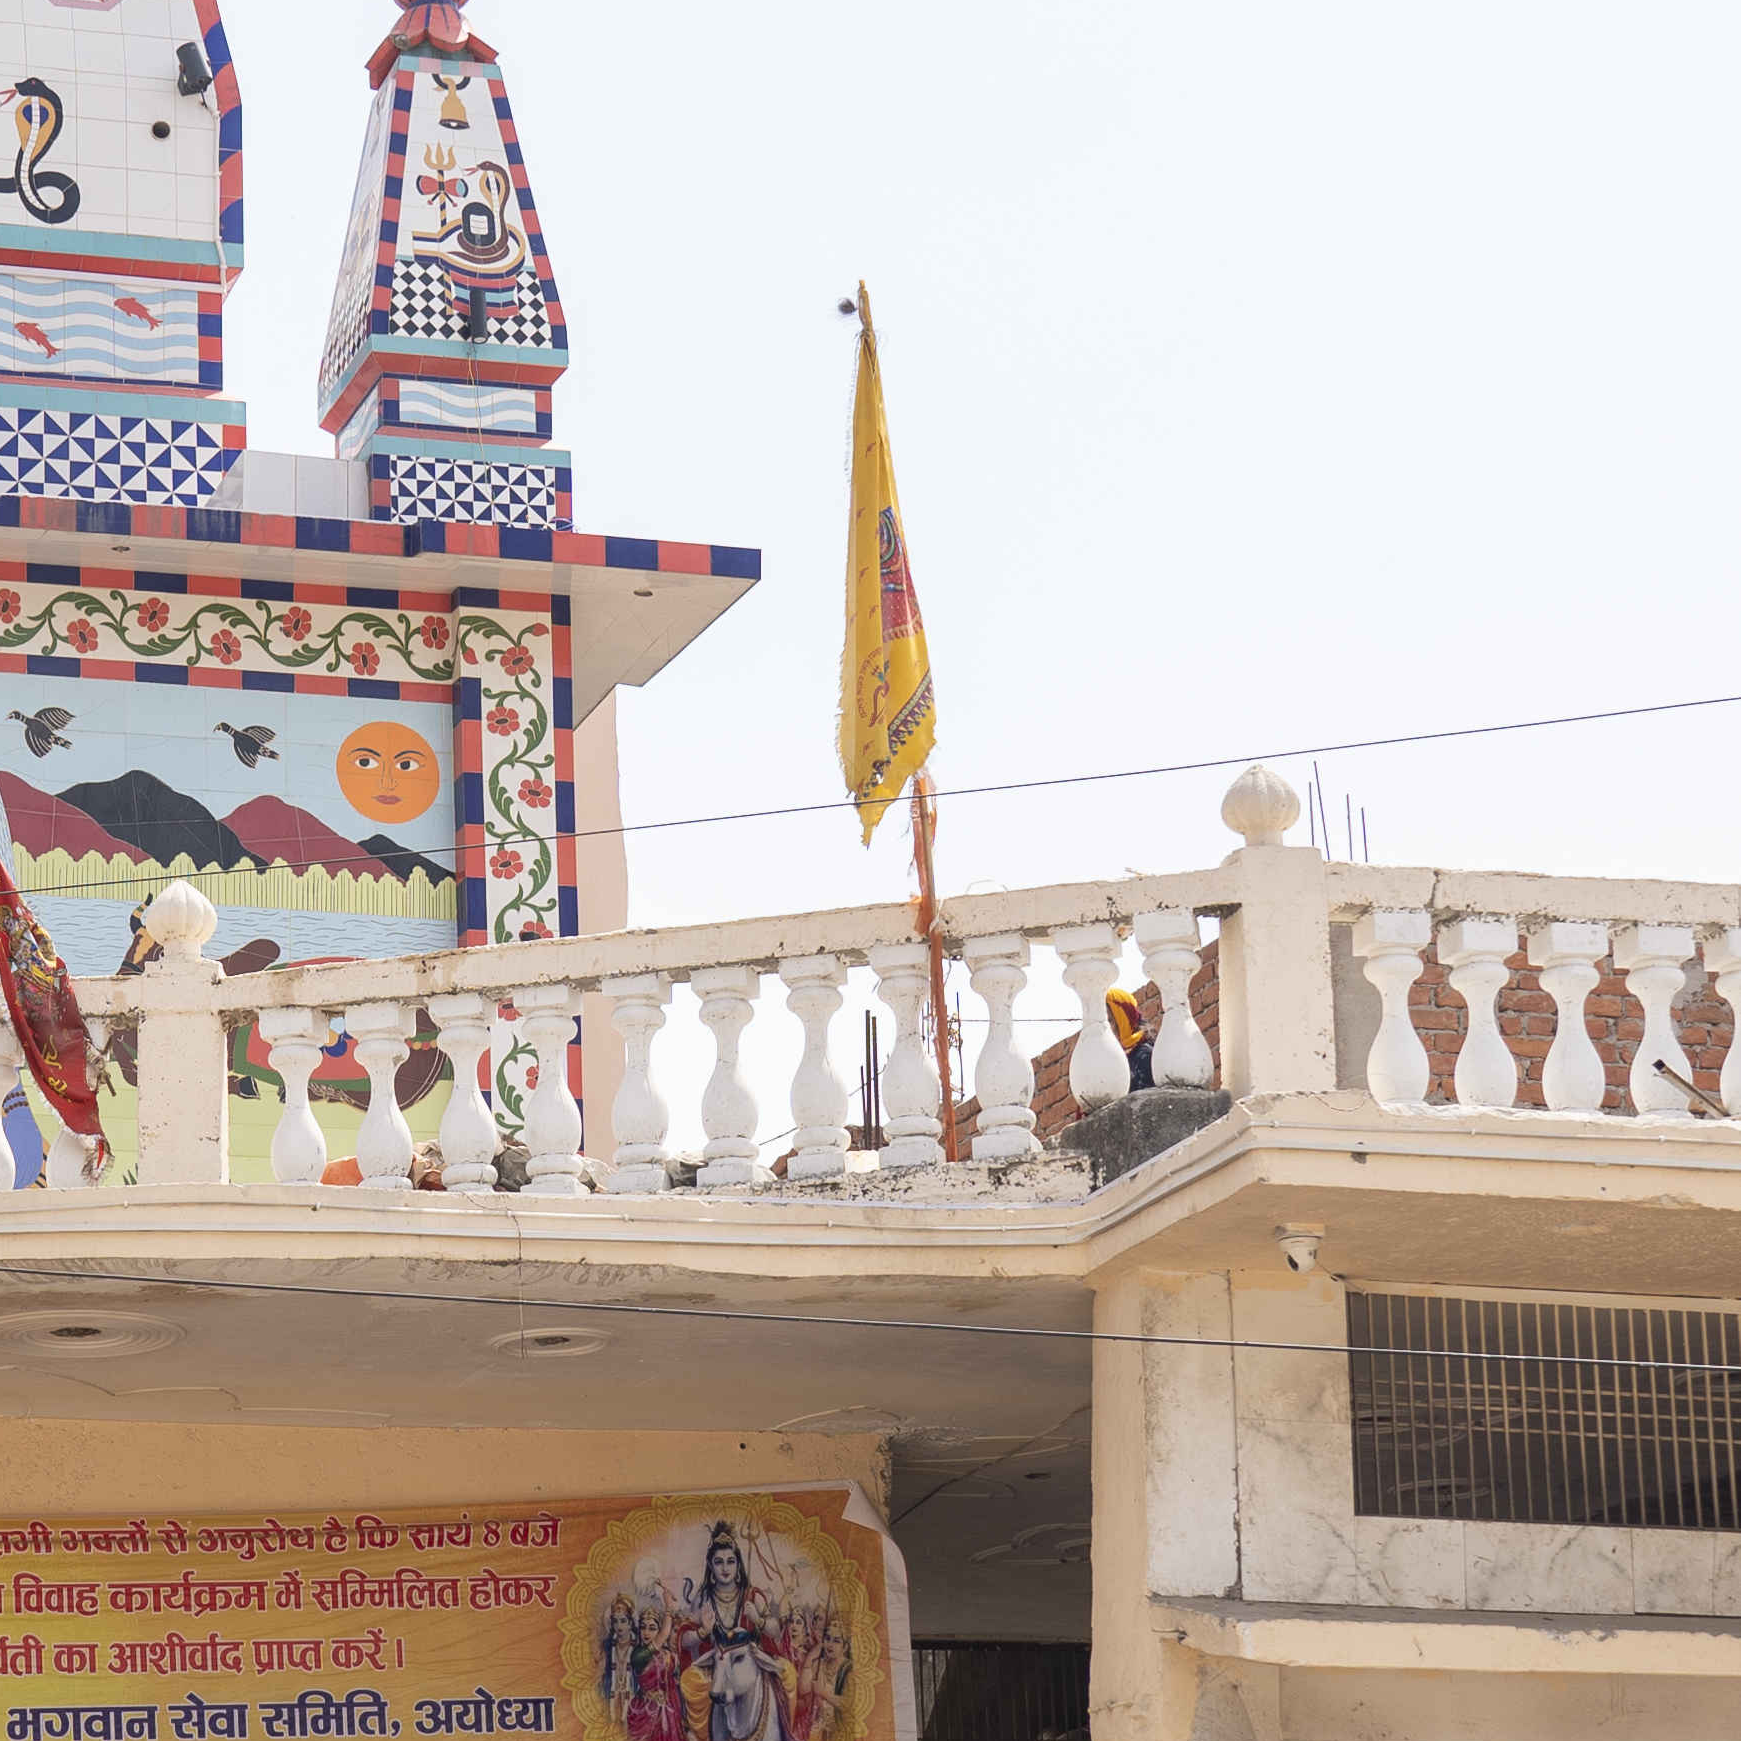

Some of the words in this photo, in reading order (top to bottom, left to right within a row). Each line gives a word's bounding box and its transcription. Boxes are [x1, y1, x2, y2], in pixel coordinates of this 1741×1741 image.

[62, 1519, 149, 1554] भक्तों
[158, 1521, 186, 1556] से
[198, 1518, 315, 1561] अनुरोध
[324, 1516, 347, 1553] है
[355, 1515, 400, 1550] कि
[407, 1512, 473, 1550] सायं
[481, 1519, 500, 1549] 8
[508, 1512, 561, 1548] बजे
[13, 1573, 101, 1616] विवाह
[108, 1570, 267, 1617] कार्यक्रम
[275, 1570, 303, 1610] में
[312, 1568, 460, 1611] सम्मिलित
[469, 1569, 556, 1609] होकर
[53, 1642, 98, 1674] का
[108, 1631, 244, 1674] आशीर्वाद
[252, 1636, 324, 1673] प्राप्त
[168, 1692, 248, 1740] सेवा
[259, 1689, 402, 1739] समिति,
[415, 1686, 555, 1735] अयोध्या
